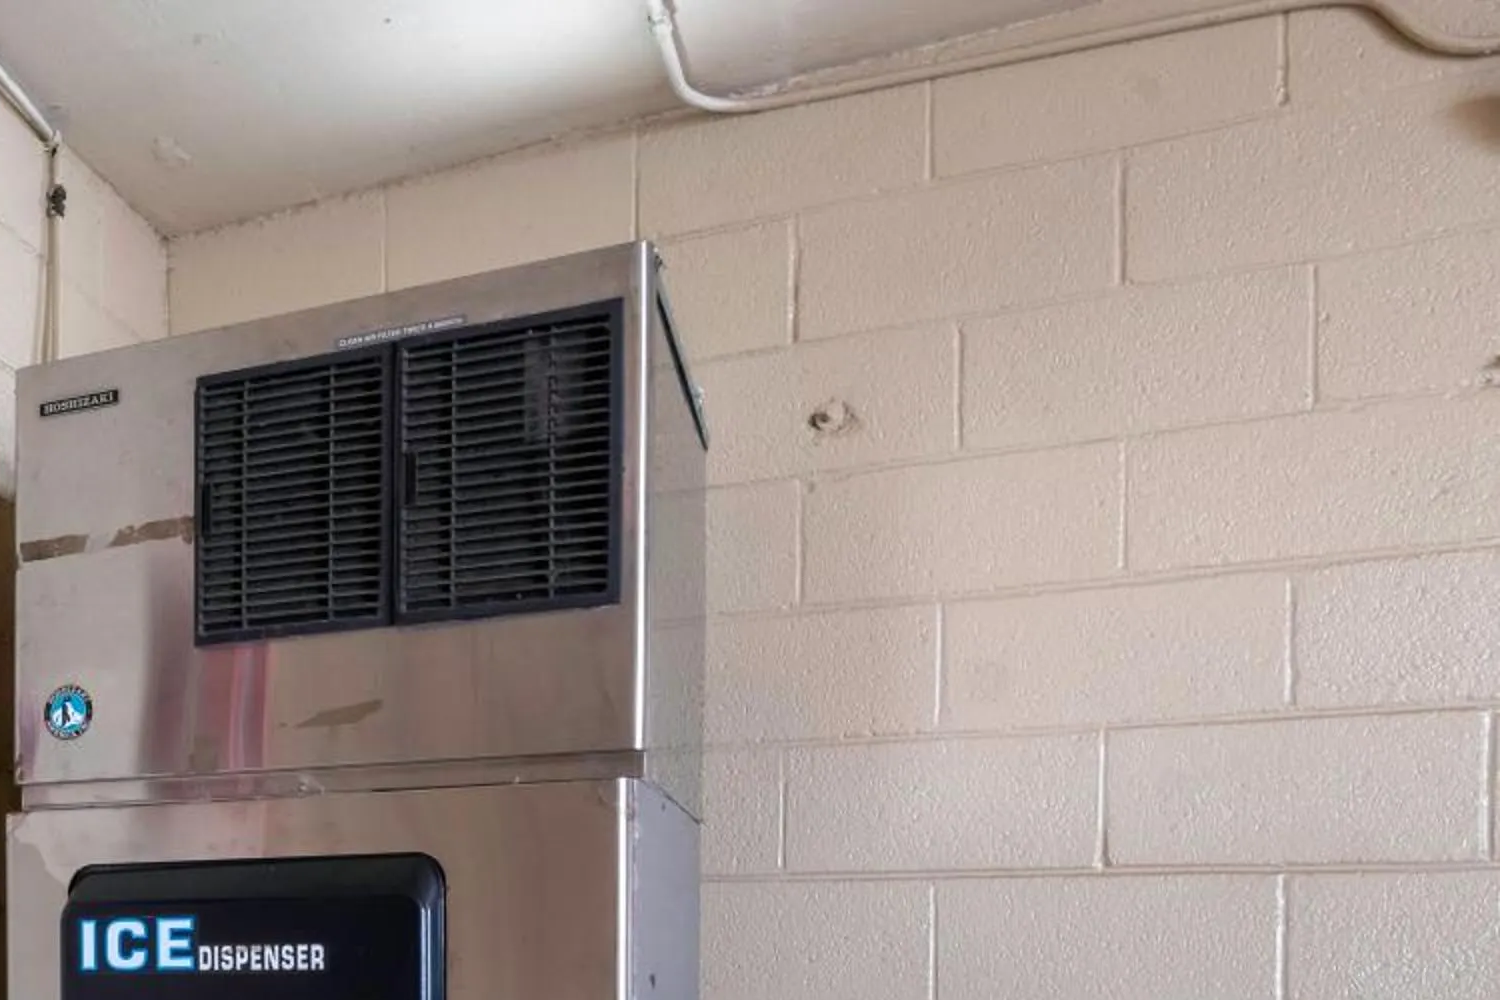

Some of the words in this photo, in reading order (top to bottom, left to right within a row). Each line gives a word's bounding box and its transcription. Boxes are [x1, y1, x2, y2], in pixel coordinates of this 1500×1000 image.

[42, 390, 115, 415] HOSHIZAKI
[78, 915, 197, 973] ICE
[198, 942, 326, 972] DISPENSER
